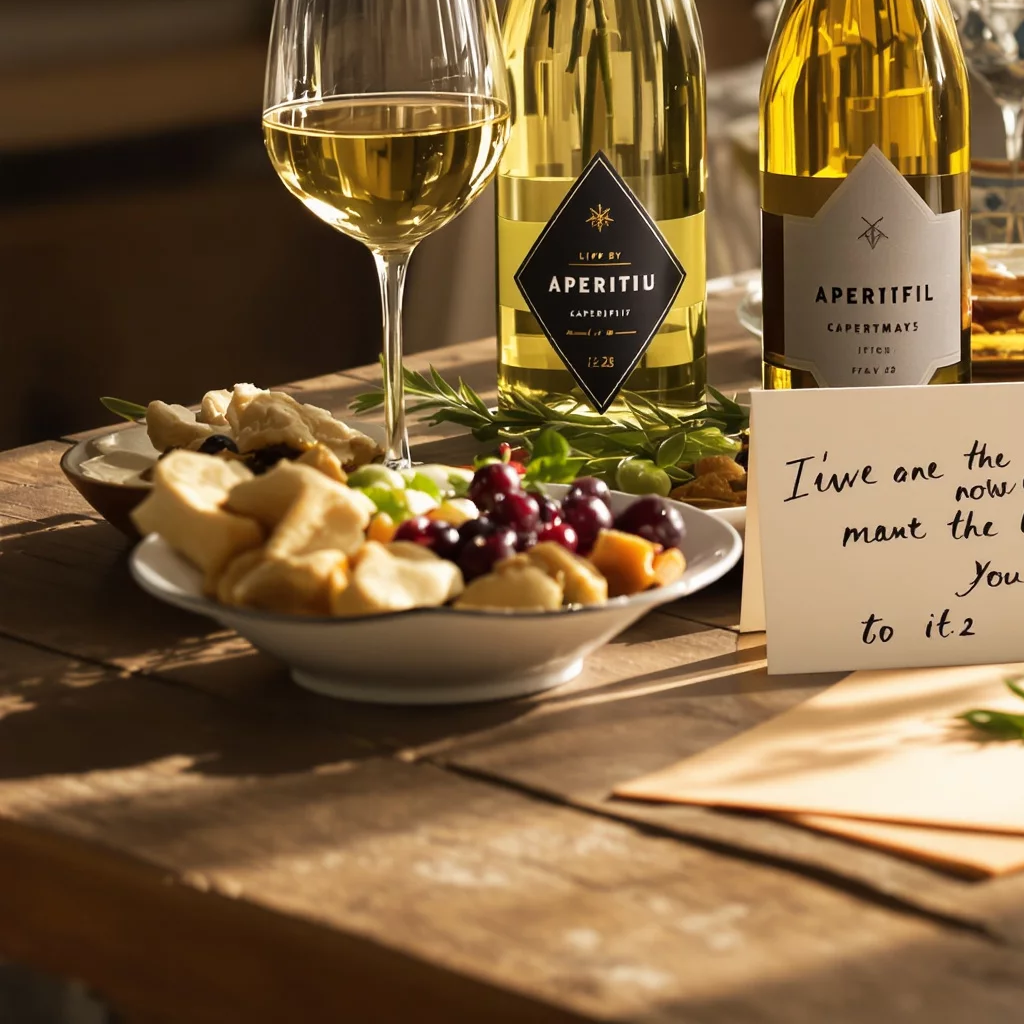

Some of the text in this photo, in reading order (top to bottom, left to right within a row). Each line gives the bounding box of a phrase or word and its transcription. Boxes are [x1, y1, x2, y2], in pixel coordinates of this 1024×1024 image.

[608, 251, 622, 261] BY
[548, 273, 655, 294] APERITIU
[963, 439, 1011, 470] the
[947, 509, 999, 540] the
[860, 613, 895, 645] to
